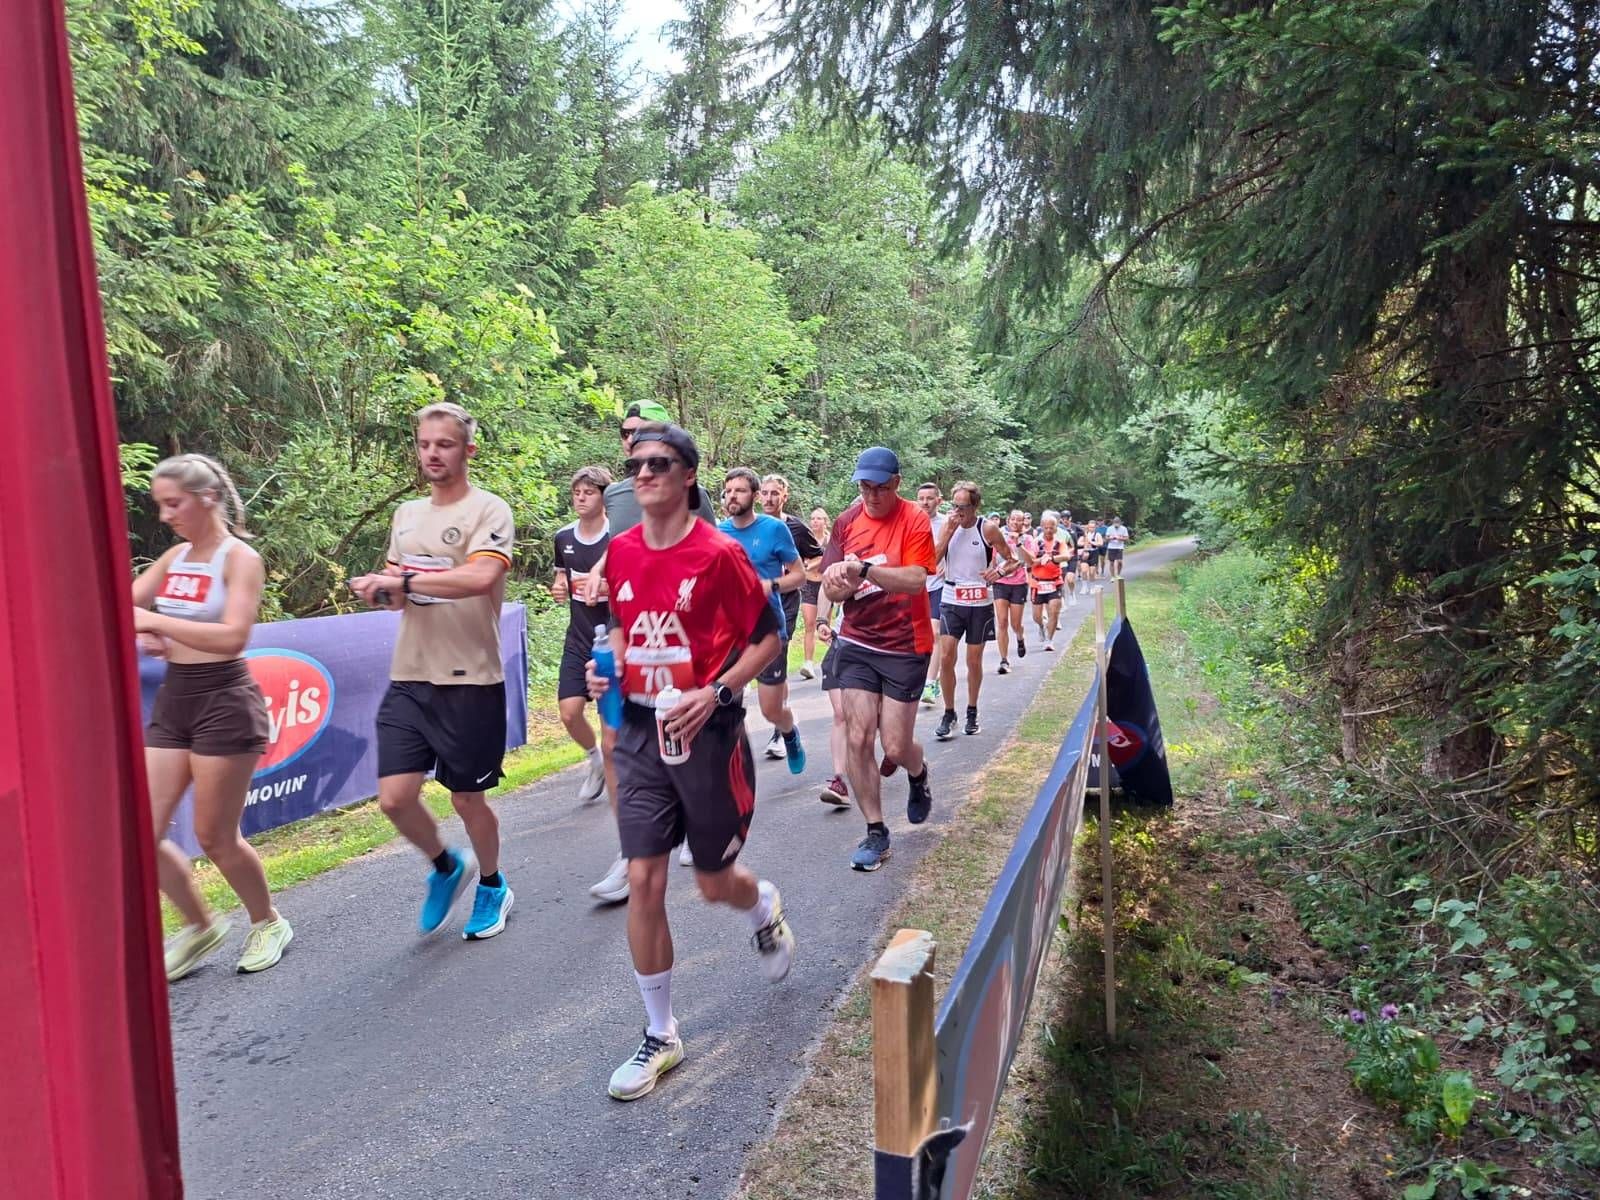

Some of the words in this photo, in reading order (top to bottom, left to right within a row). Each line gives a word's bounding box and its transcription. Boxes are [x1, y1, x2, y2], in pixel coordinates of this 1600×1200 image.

[961, 588, 982, 600] 218
[627, 610, 691, 649] AXA
[640, 666, 674, 693] 70
